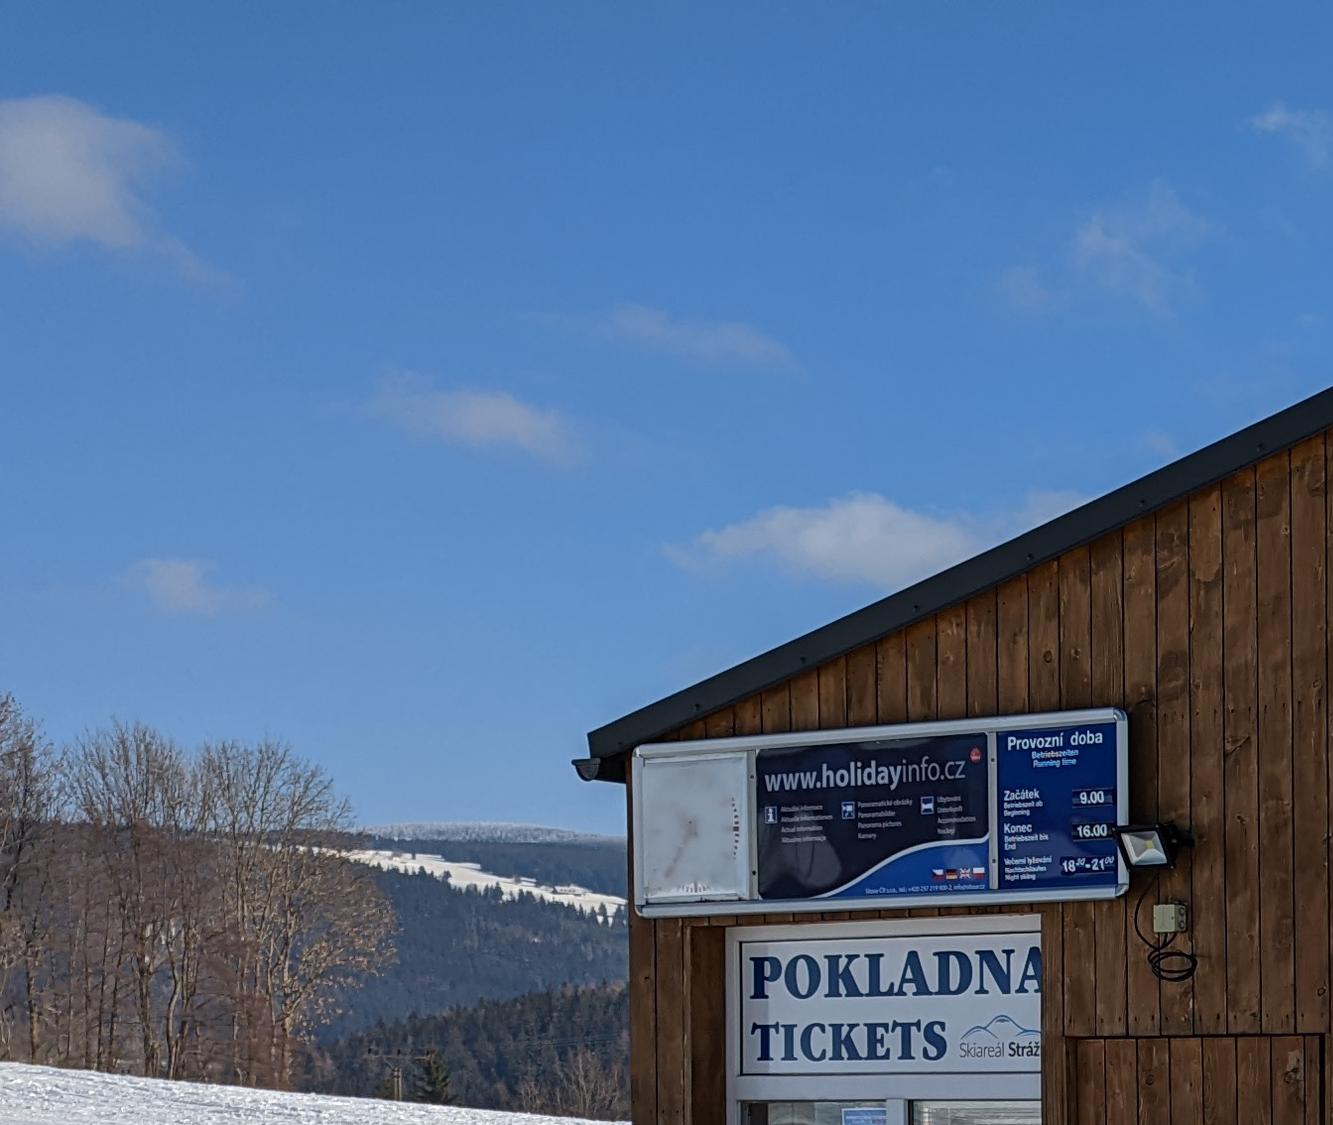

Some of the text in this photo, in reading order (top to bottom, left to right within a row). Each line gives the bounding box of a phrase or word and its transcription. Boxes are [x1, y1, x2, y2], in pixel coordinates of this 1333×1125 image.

[1008, 731, 1103, 750] Provozní doba
[764, 756, 966, 792] www.holidayinfo.cz
[1004, 788, 1040, 801] Začátek
[1079, 791, 1105, 805] 9.00
[1004, 823, 1032, 834] Konec
[1077, 824, 1108, 838] 16.00
[749, 947, 1042, 999] POKLADNA
[751, 1019, 947, 1062] TICKETS
[959, 1039, 1040, 1059] Skiareál Stráž
